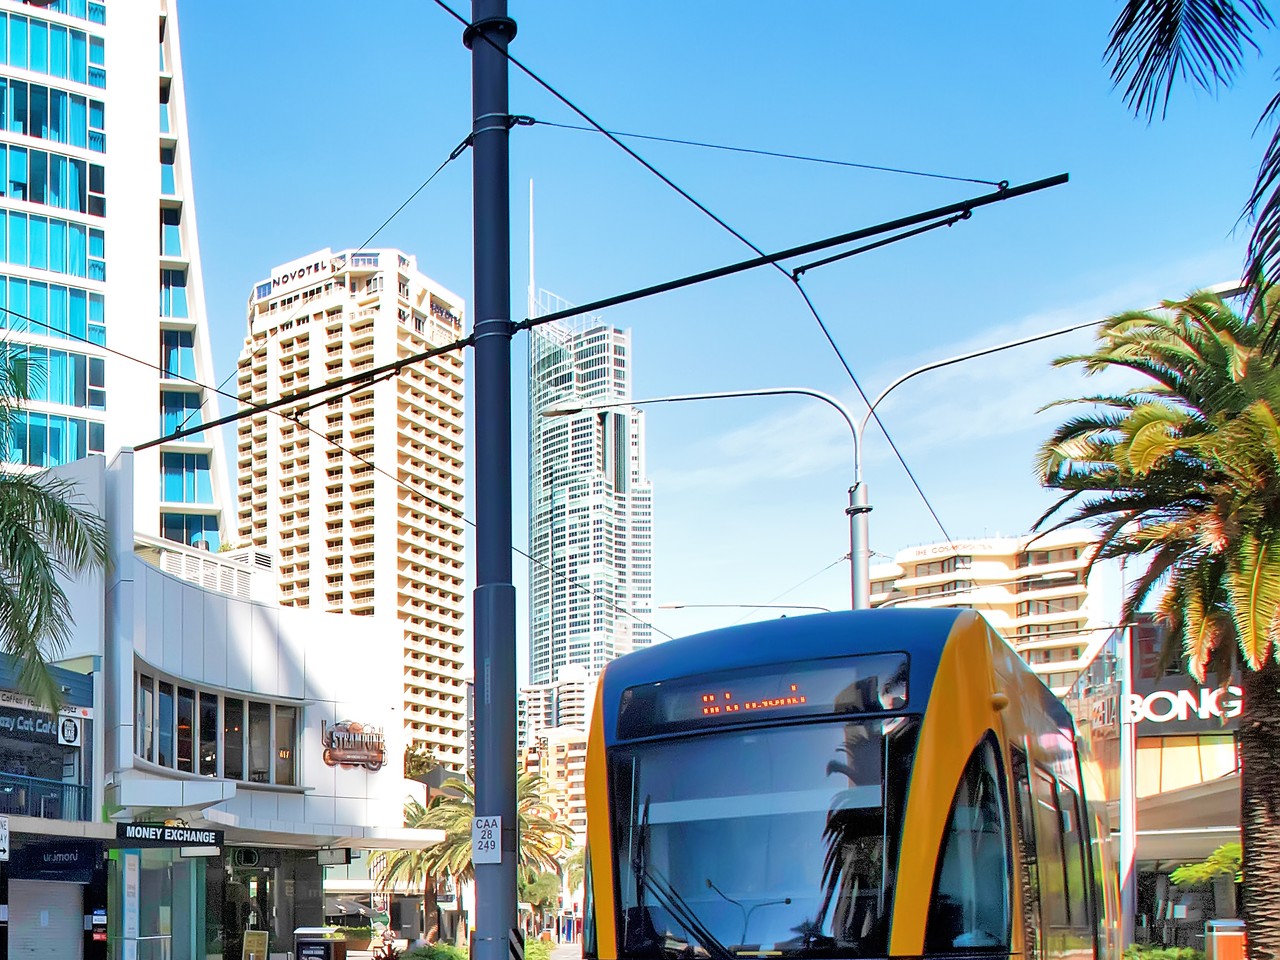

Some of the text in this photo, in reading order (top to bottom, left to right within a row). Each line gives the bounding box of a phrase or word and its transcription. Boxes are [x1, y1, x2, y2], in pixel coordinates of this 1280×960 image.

[272, 260, 327, 288] NOVOTEL
[17, 716, 34, 731] Cat
[476, 819, 498, 829] CAA
[126, 825, 216, 844] MONEY EXCHANGE
[480, 829, 493, 840] 28
[477, 840, 496, 850] 249
